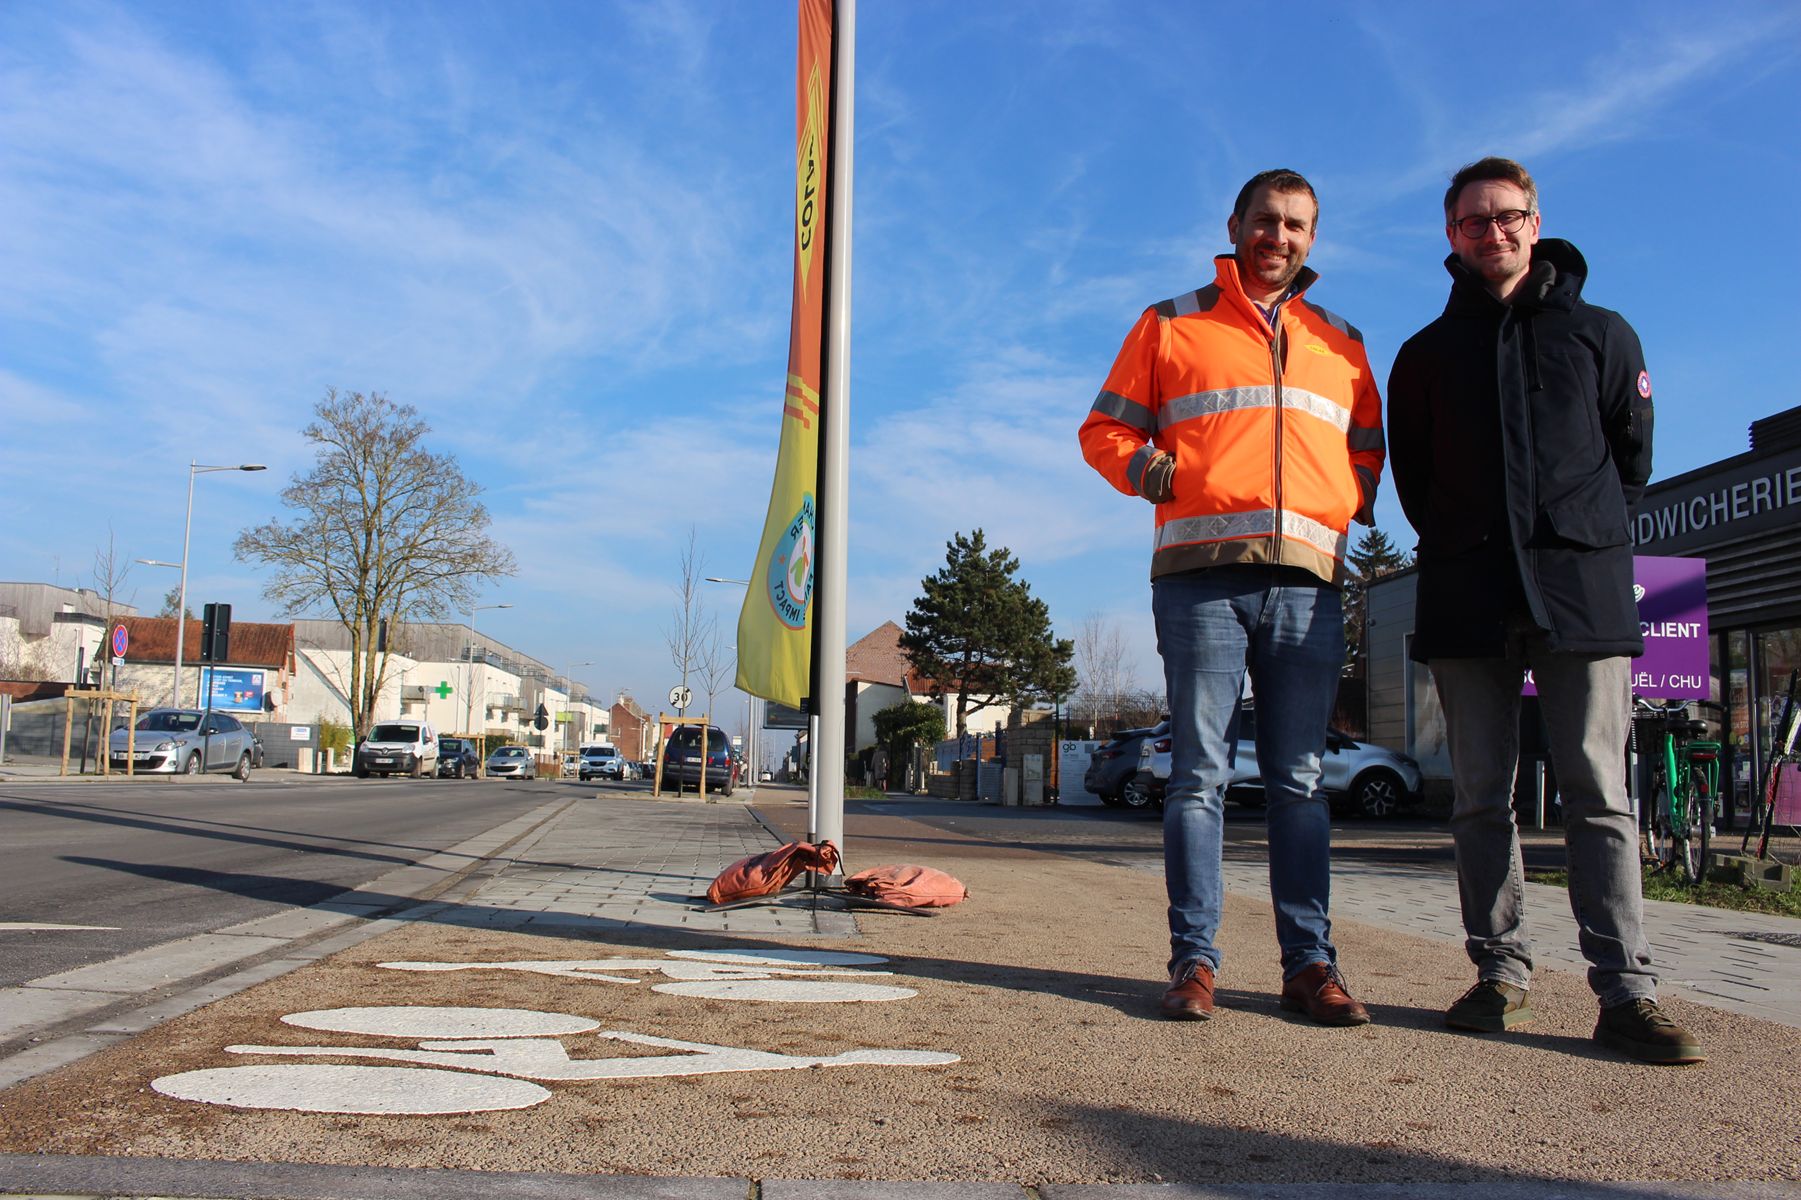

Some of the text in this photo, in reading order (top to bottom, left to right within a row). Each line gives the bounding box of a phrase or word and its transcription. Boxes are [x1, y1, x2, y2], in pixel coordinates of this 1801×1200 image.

[1669, 674, 1702, 689] CHU
[674, 693, 688, 702] 30
[1063, 741, 1076, 753] gb
